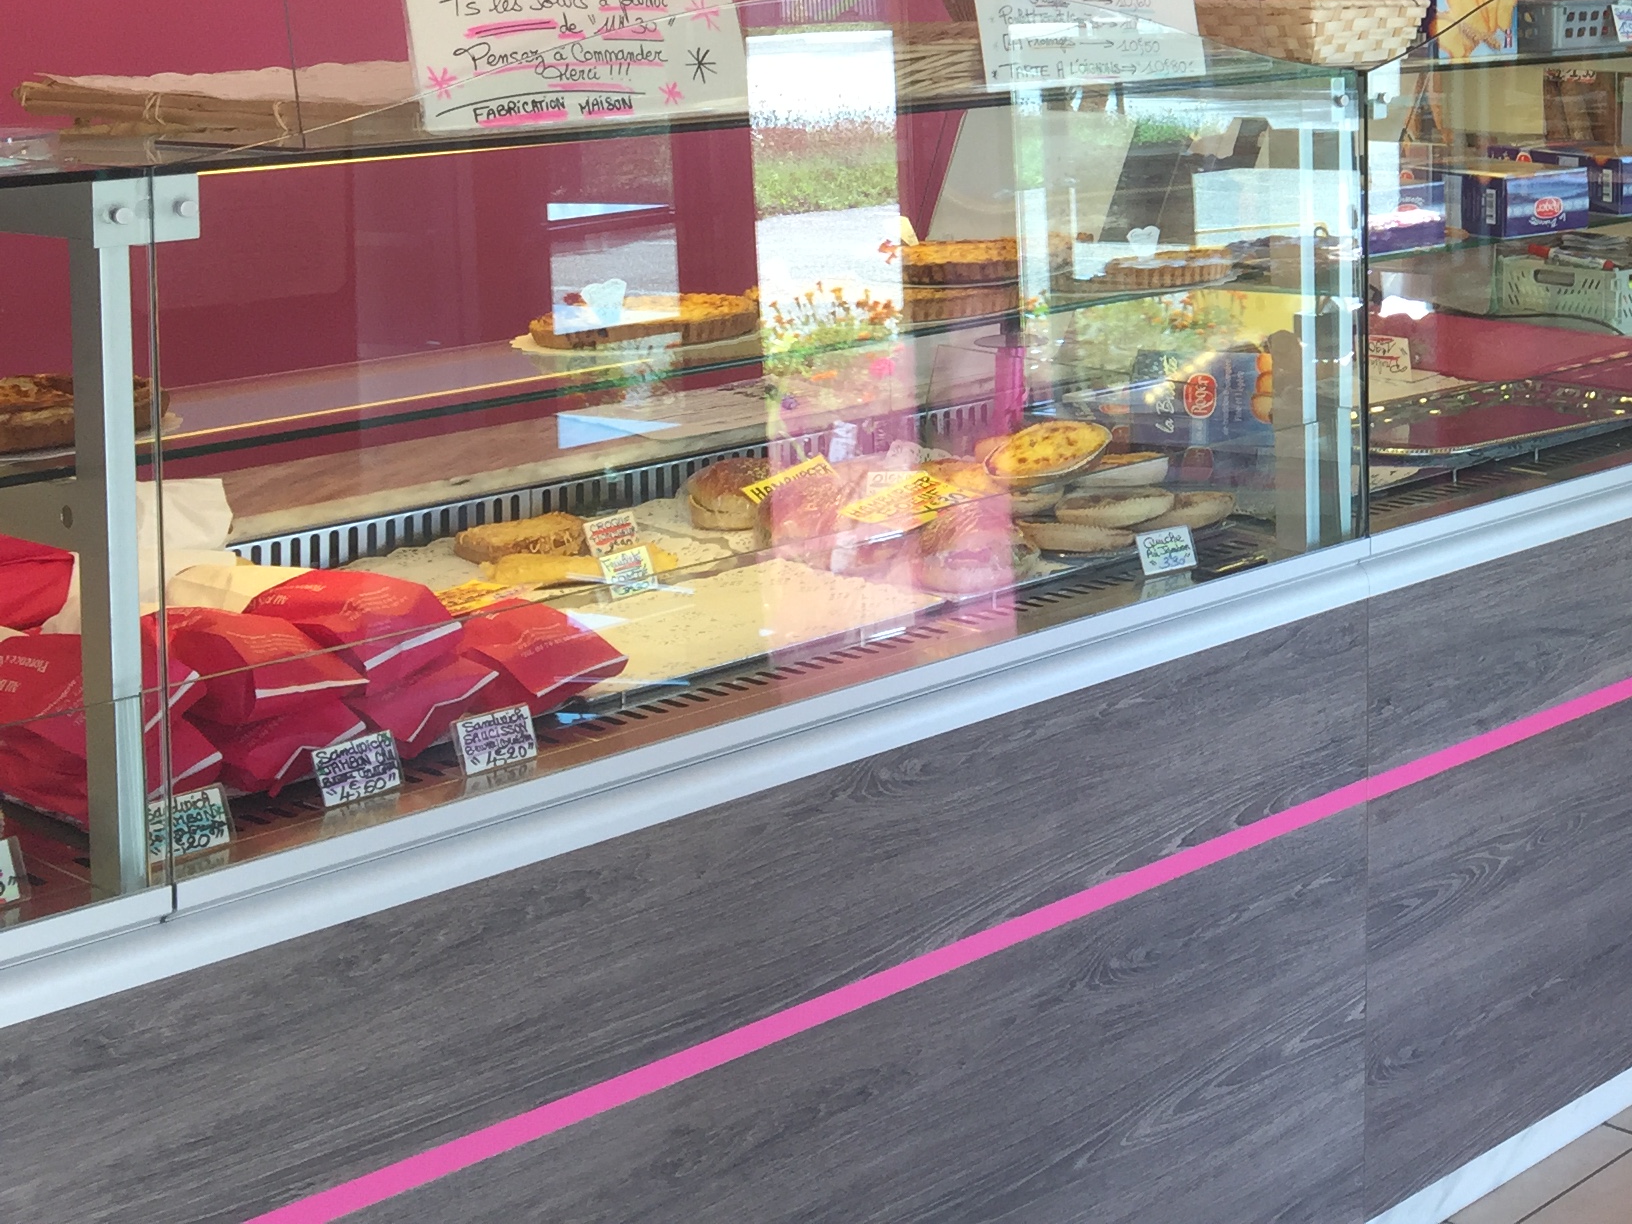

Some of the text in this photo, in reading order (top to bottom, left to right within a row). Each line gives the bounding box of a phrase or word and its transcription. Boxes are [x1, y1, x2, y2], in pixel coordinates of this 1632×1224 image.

[558, 12, 579, 35] de
[571, 40, 669, 65] Commander
[1189, 374, 1212, 415] Roger
[462, 708, 529, 734] Sandwich
[316, 733, 393, 765] Sandwich
[320, 755, 371, 776] JAMBON
